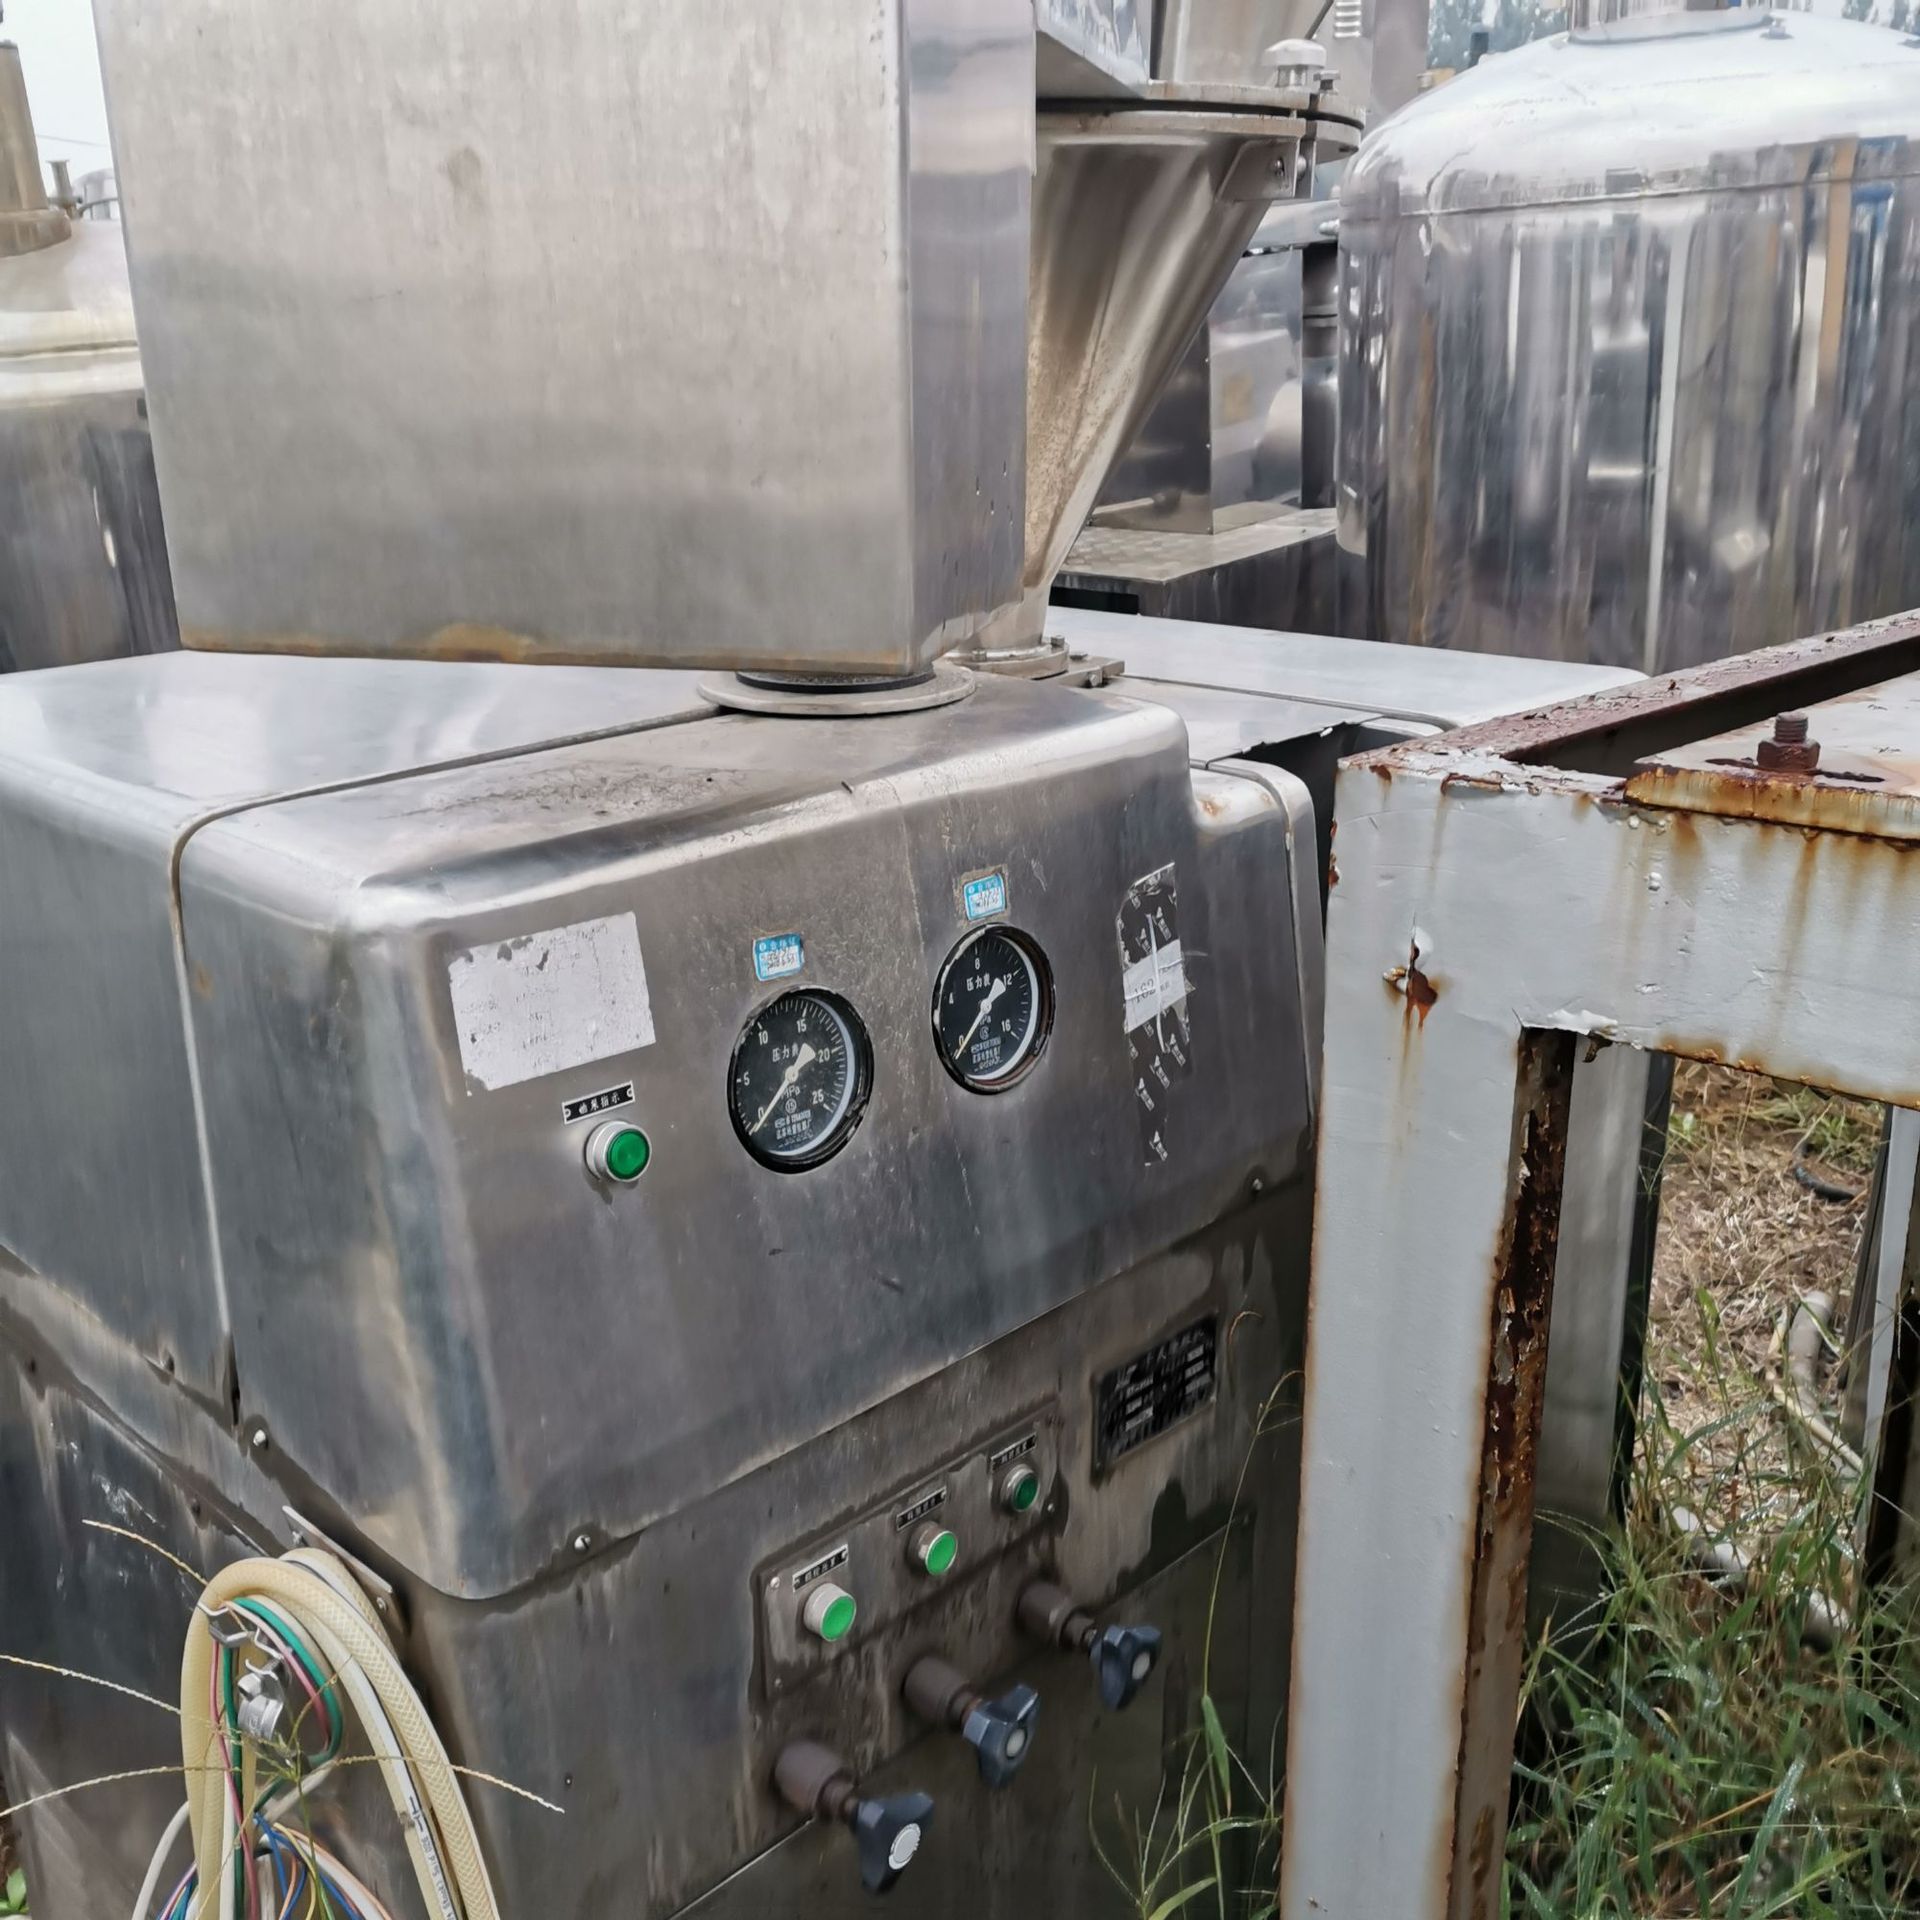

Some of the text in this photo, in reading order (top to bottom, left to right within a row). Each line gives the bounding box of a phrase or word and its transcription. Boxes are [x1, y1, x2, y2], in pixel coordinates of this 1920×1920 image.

[966, 972, 991, 991] 压力表
[1003, 972, 1013, 986] 12
[948, 992, 954, 1005] 4
[796, 1018, 807, 1033] 15
[1001, 1018, 1011, 1032] 16
[758, 1030, 769, 1046] 10
[772, 1042, 799, 1062] 压力表
[817, 1047, 830, 1063] 20
[743, 1071, 750, 1086] 5
[812, 1088, 824, 1105] 25
